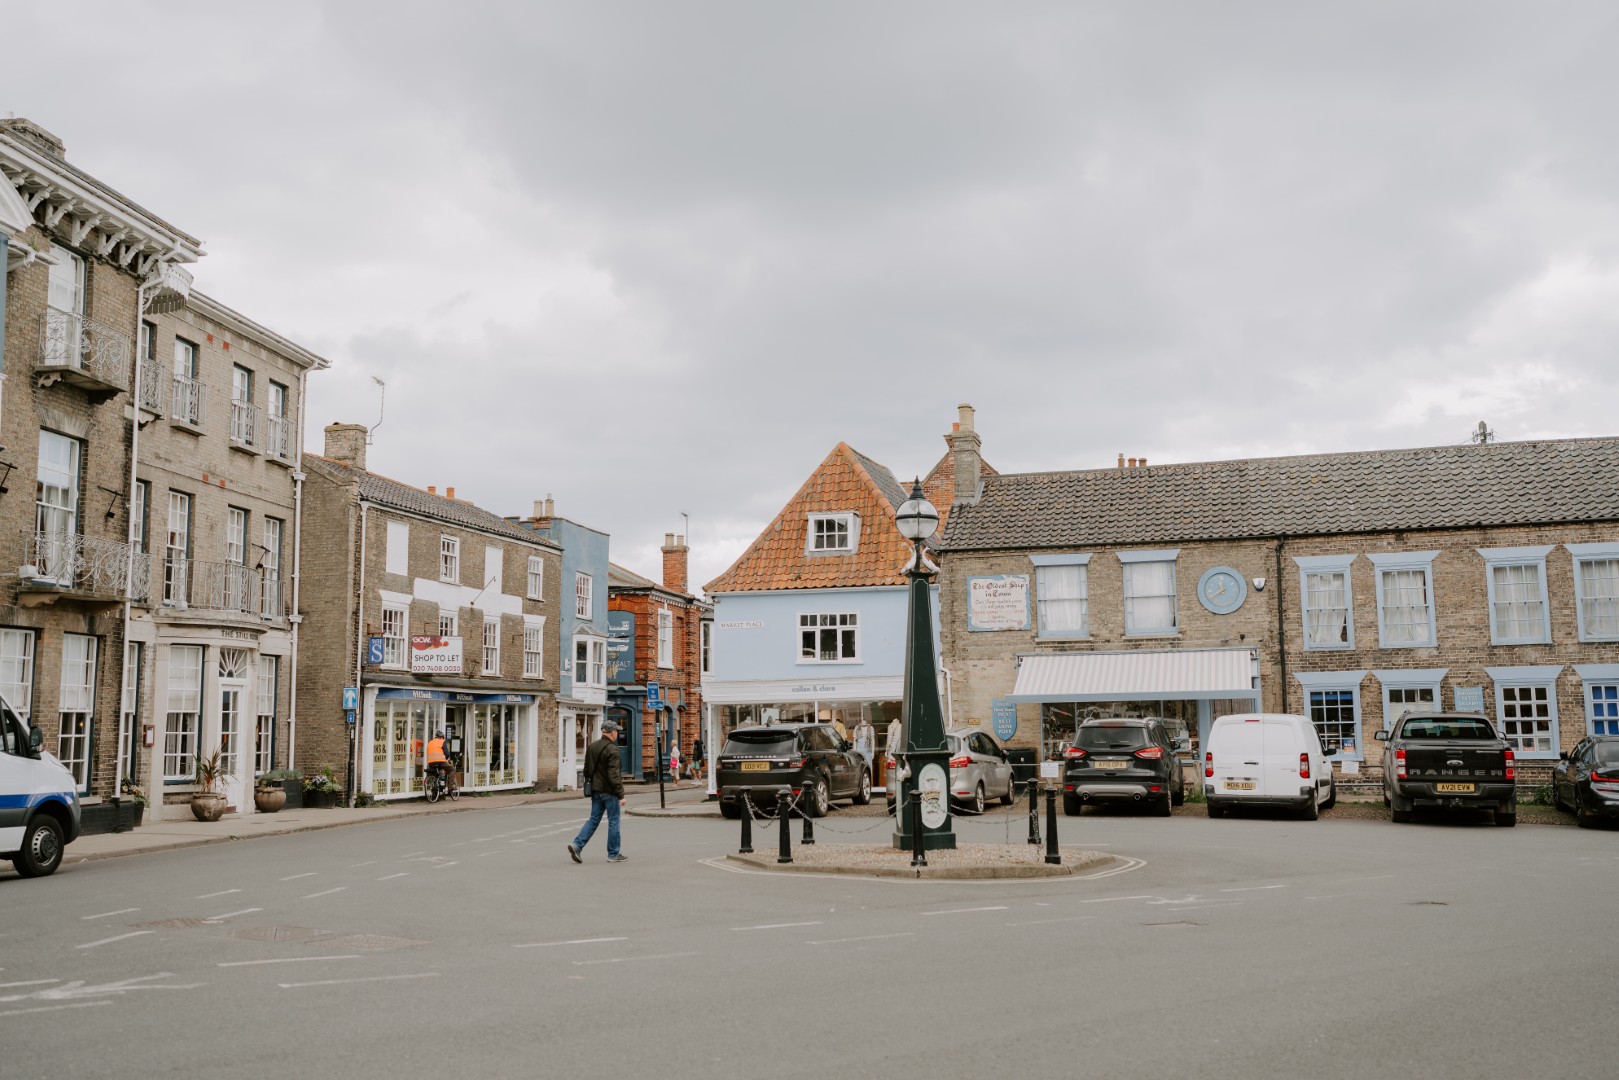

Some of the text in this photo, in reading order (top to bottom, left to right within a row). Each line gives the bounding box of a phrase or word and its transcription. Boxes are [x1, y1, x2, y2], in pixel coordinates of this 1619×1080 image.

[221, 629, 234, 638] THE
[235, 631, 249, 639] STILL
[371, 644, 383, 662] S
[414, 654, 460, 662] SHOP TO LET
[812, 685, 818, 693] &
